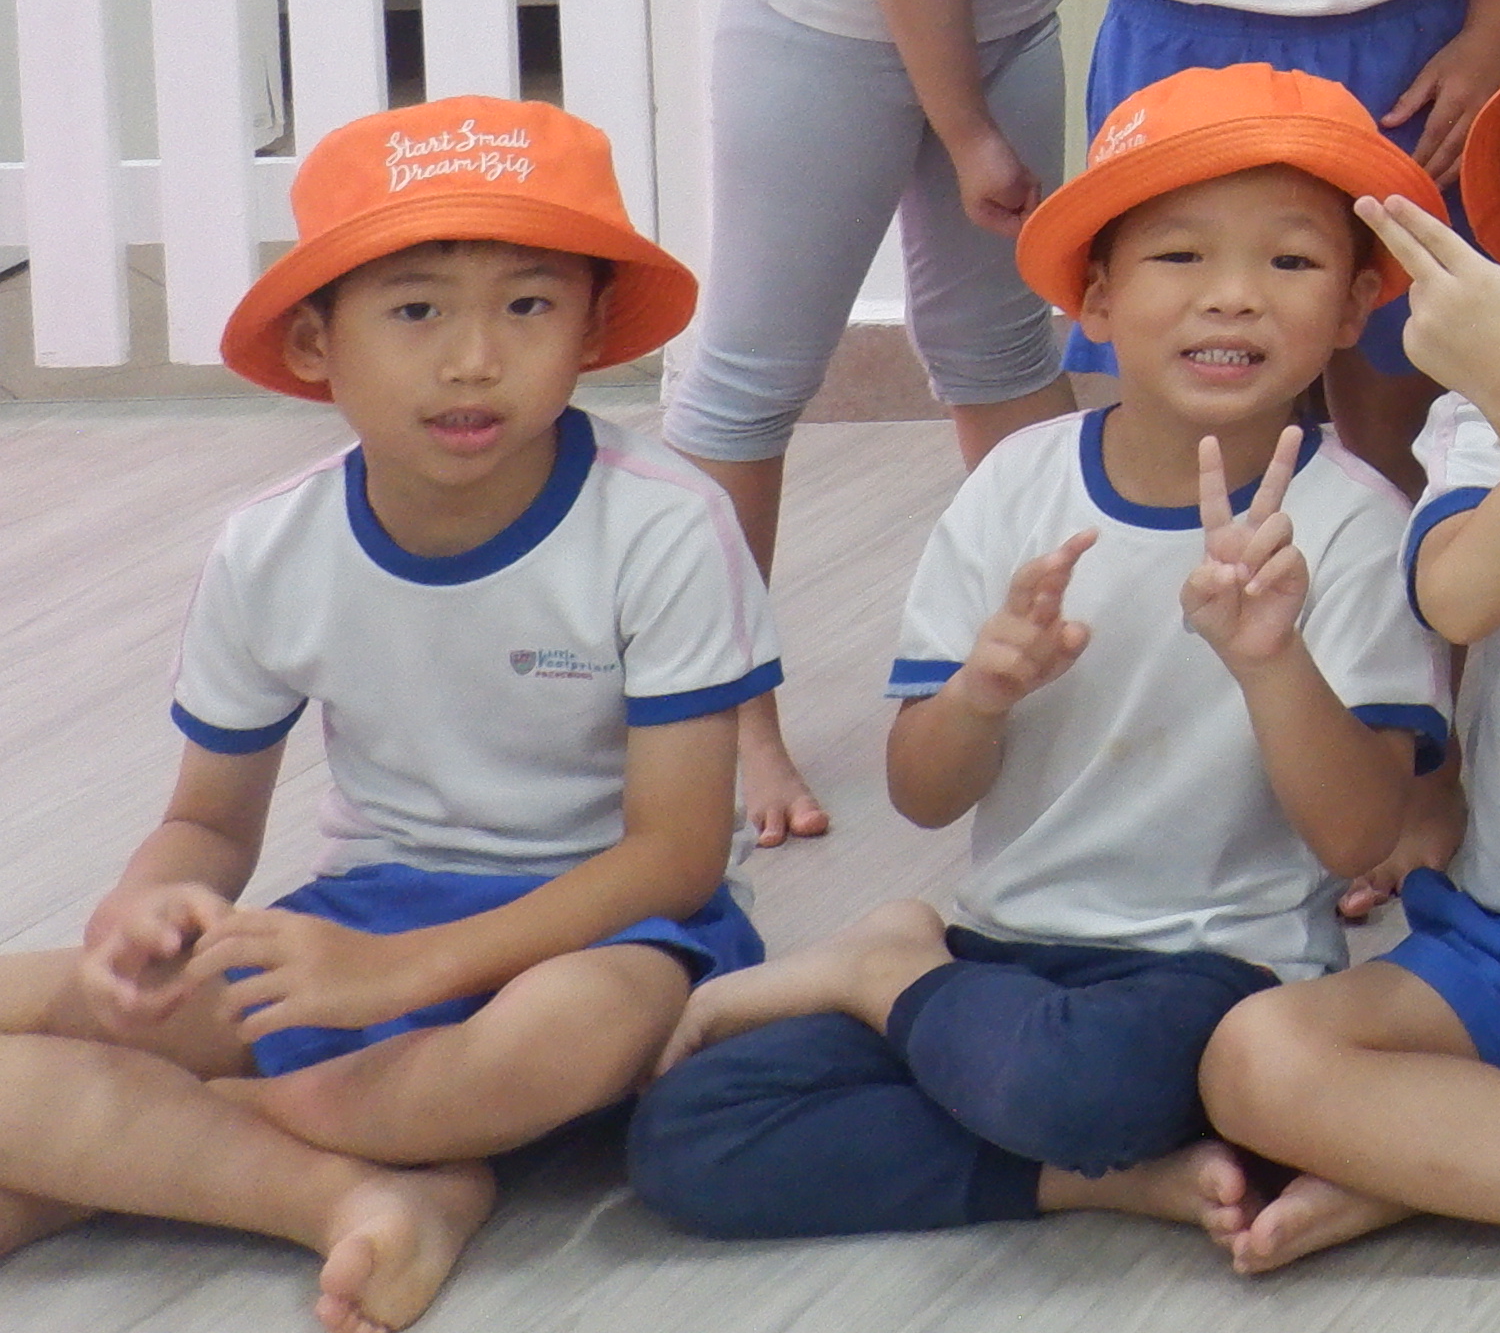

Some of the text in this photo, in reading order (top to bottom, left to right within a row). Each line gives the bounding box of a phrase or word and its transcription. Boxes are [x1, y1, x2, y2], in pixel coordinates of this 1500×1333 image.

[386, 119, 530, 163] Start Small
[387, 152, 535, 193] Dream Big
